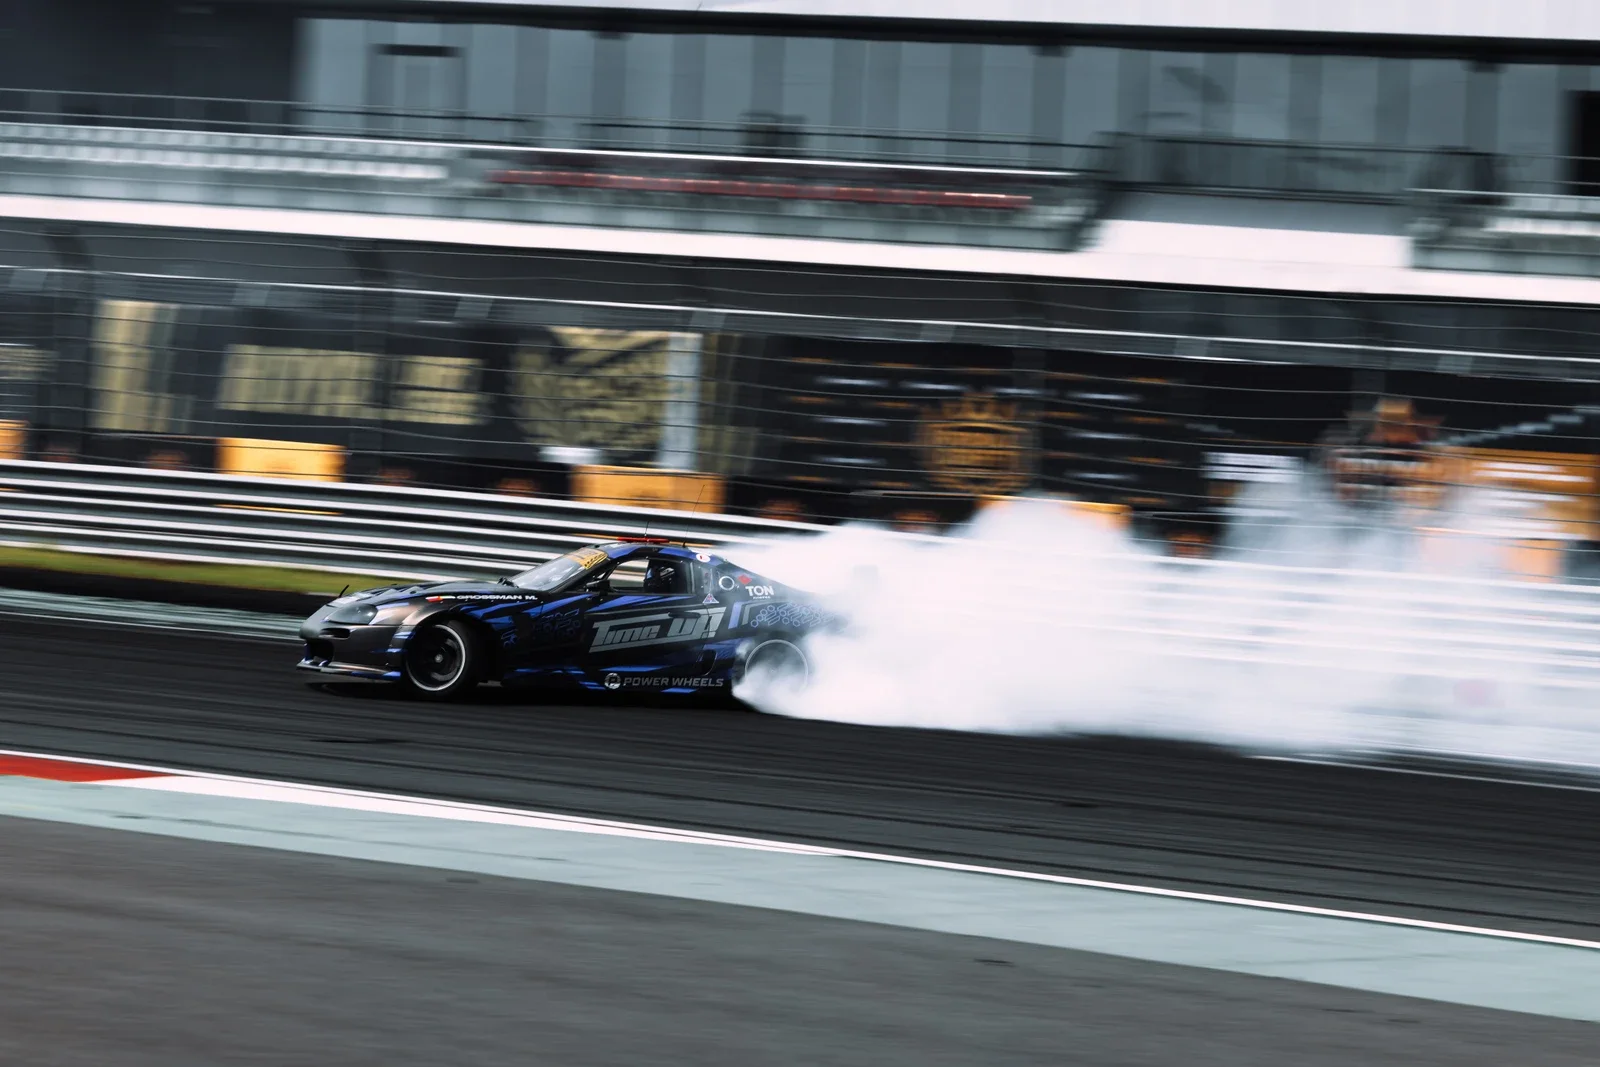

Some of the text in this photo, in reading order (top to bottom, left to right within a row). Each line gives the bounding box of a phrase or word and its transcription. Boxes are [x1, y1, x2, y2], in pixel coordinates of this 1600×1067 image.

[745, 585, 775, 597] TON
[623, 677, 725, 687] POWER WHEELS
